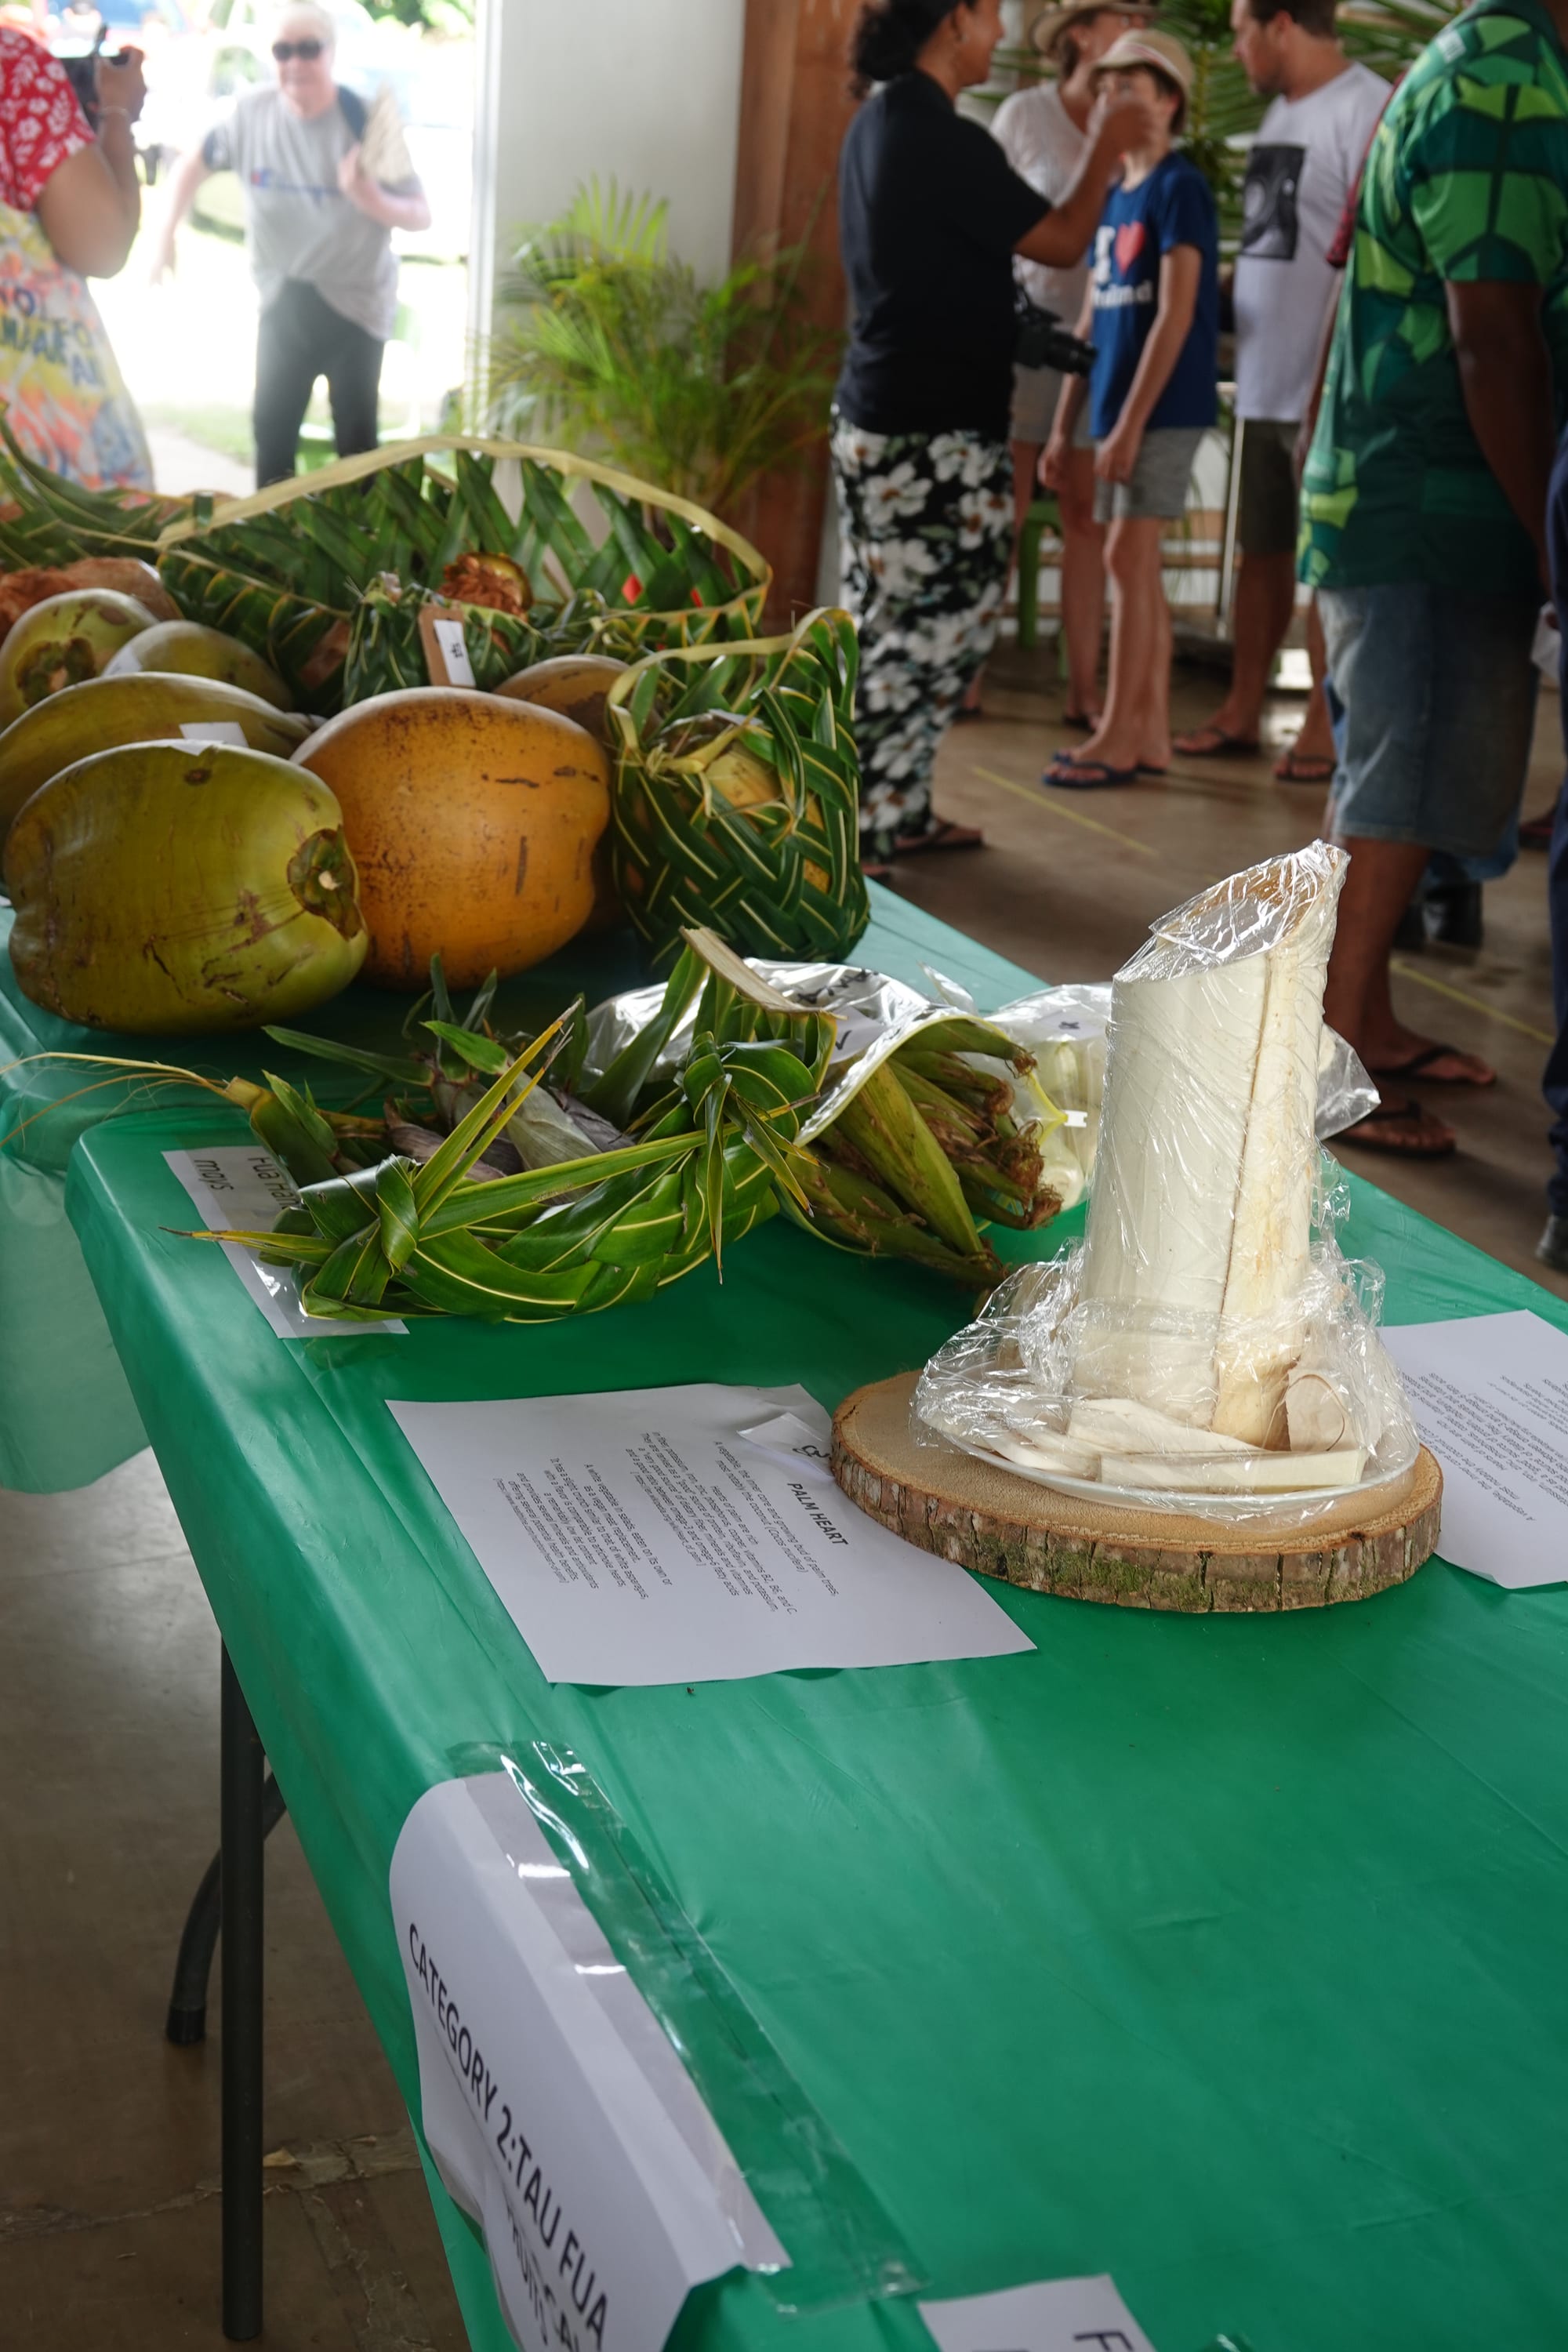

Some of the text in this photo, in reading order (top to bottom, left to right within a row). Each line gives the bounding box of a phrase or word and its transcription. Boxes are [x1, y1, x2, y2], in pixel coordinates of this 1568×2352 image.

[787, 1483, 819, 1510] PALM
[809, 1513, 849, 1545] HEART
[408, 1922, 497, 2120] CATEGORY
[495, 2105, 561, 2249] 2:TAU
[558, 2230, 608, 2351] FUA
